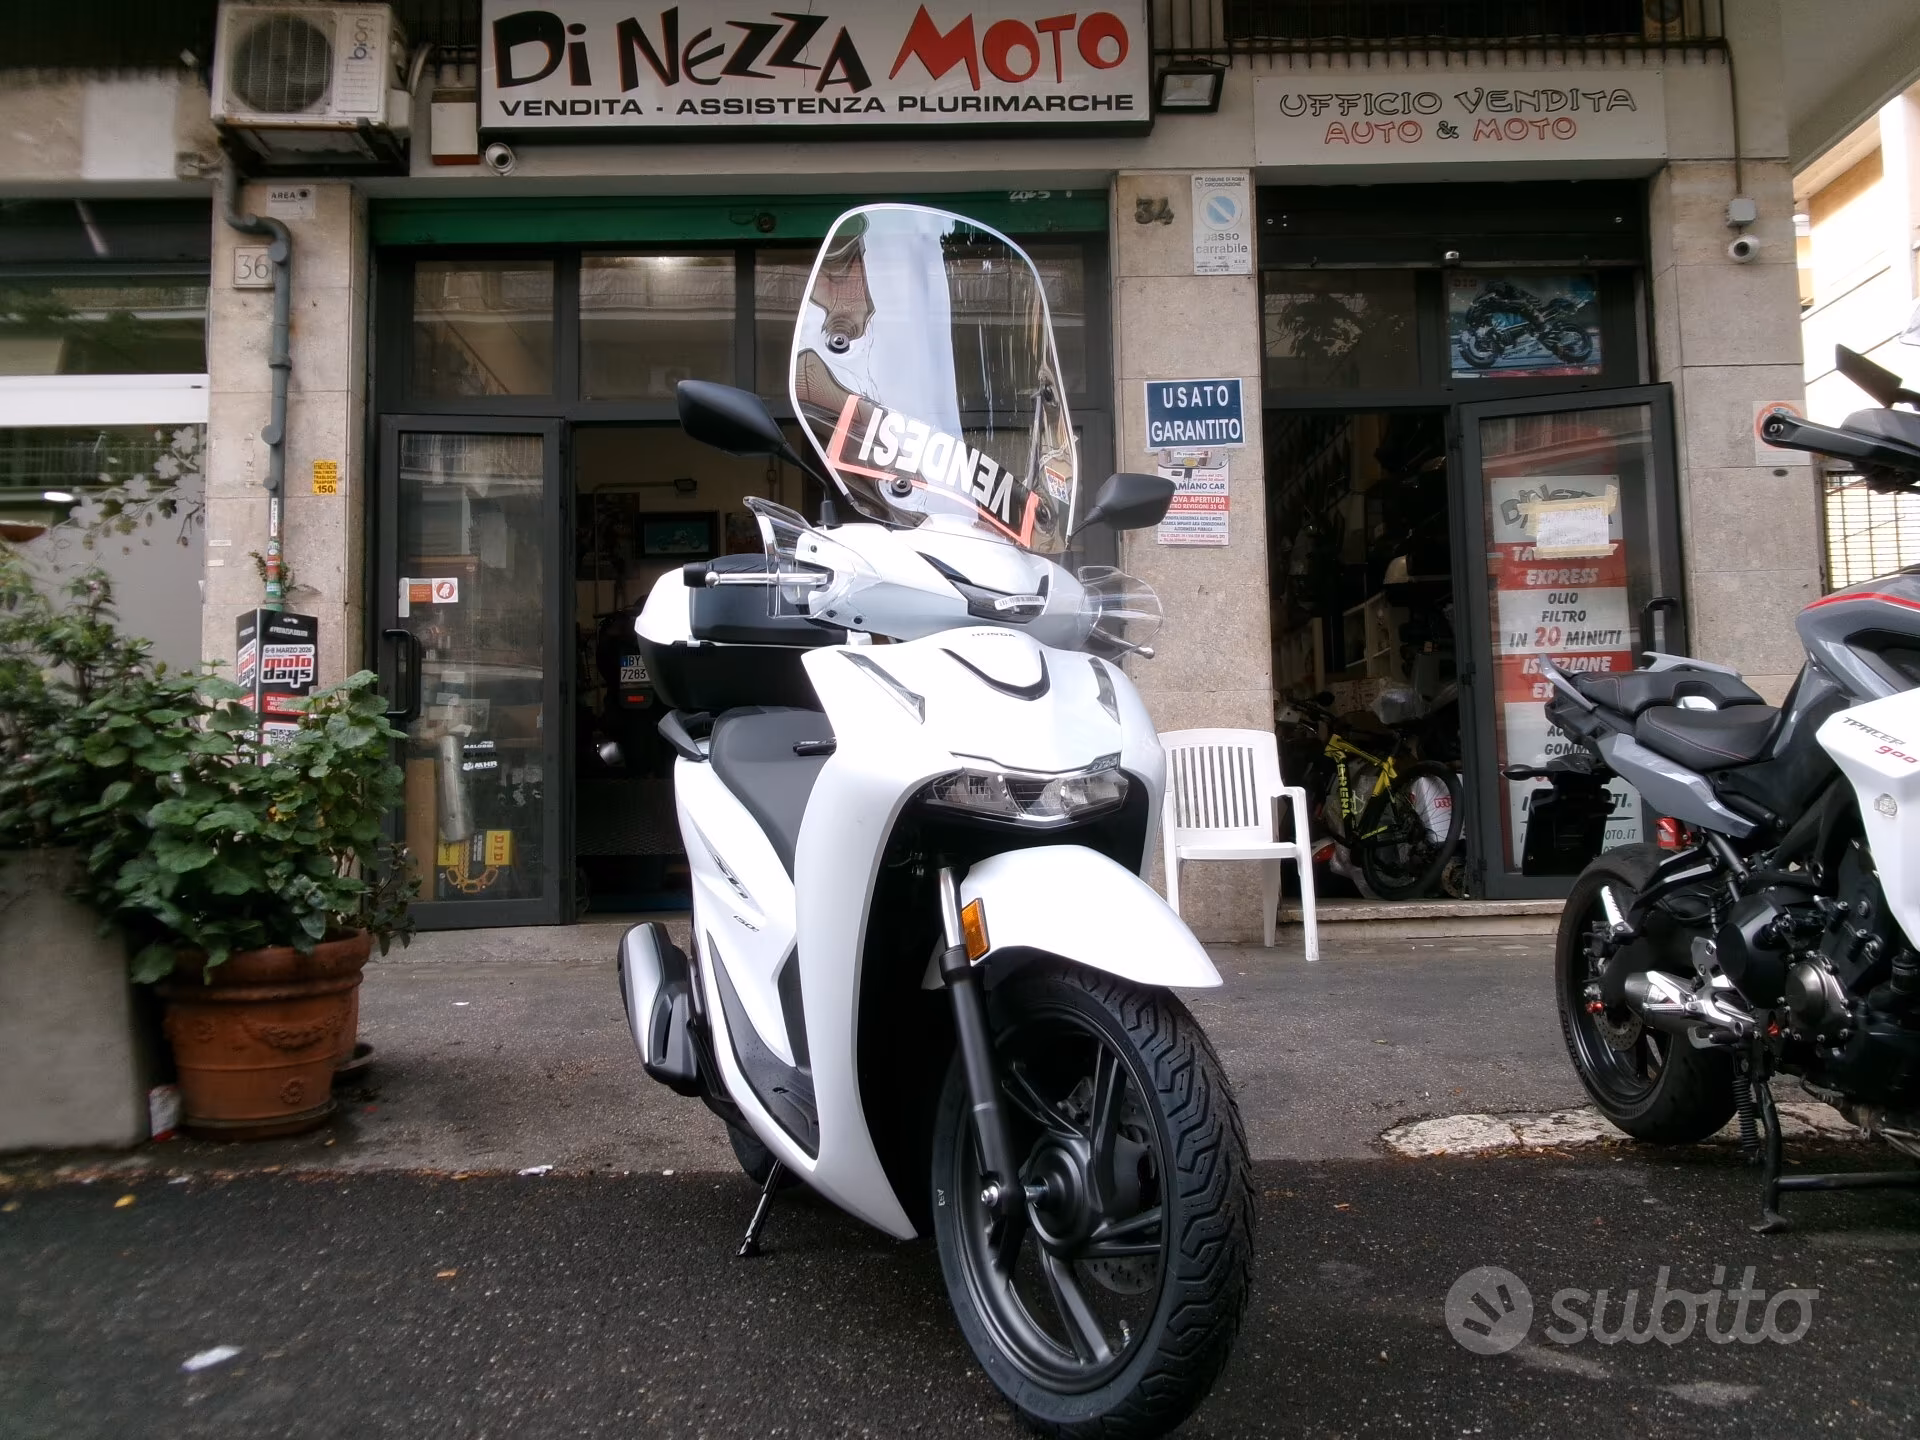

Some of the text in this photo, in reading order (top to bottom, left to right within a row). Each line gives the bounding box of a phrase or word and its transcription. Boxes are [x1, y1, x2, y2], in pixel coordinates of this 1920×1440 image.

[493, 10, 592, 88] Di
[888, 4, 1129, 91] MOTO
[499, 98, 643, 116] VENDITA
[676, 96, 886, 116] ASSISTENZA
[898, 94, 1134, 113] PLURIMARCHE
[1279, 87, 1637, 117] UFFICIO VENDITA
[1324, 117, 1577, 144] AUTO & MOTO
[1204, 232, 1240, 243] passo
[1195, 243, 1248, 253] carrabile
[237, 254, 269, 279] 36
[1163, 385, 1229, 409] USATO
[1151, 418, 1241, 442] GARANTITO
[1209, 482, 1225, 490] CAR
[1526, 568, 1599, 585] EXPRESS
[1548, 592, 1578, 604] OLIO
[1542, 610, 1586, 622] FILTRO
[1510, 626, 1622, 647] IN 20 MINUTI
[1522, 657, 1612, 674] ISEZIONE
[263, 669, 311, 685] days
[1875, 745, 1918, 763] 900
